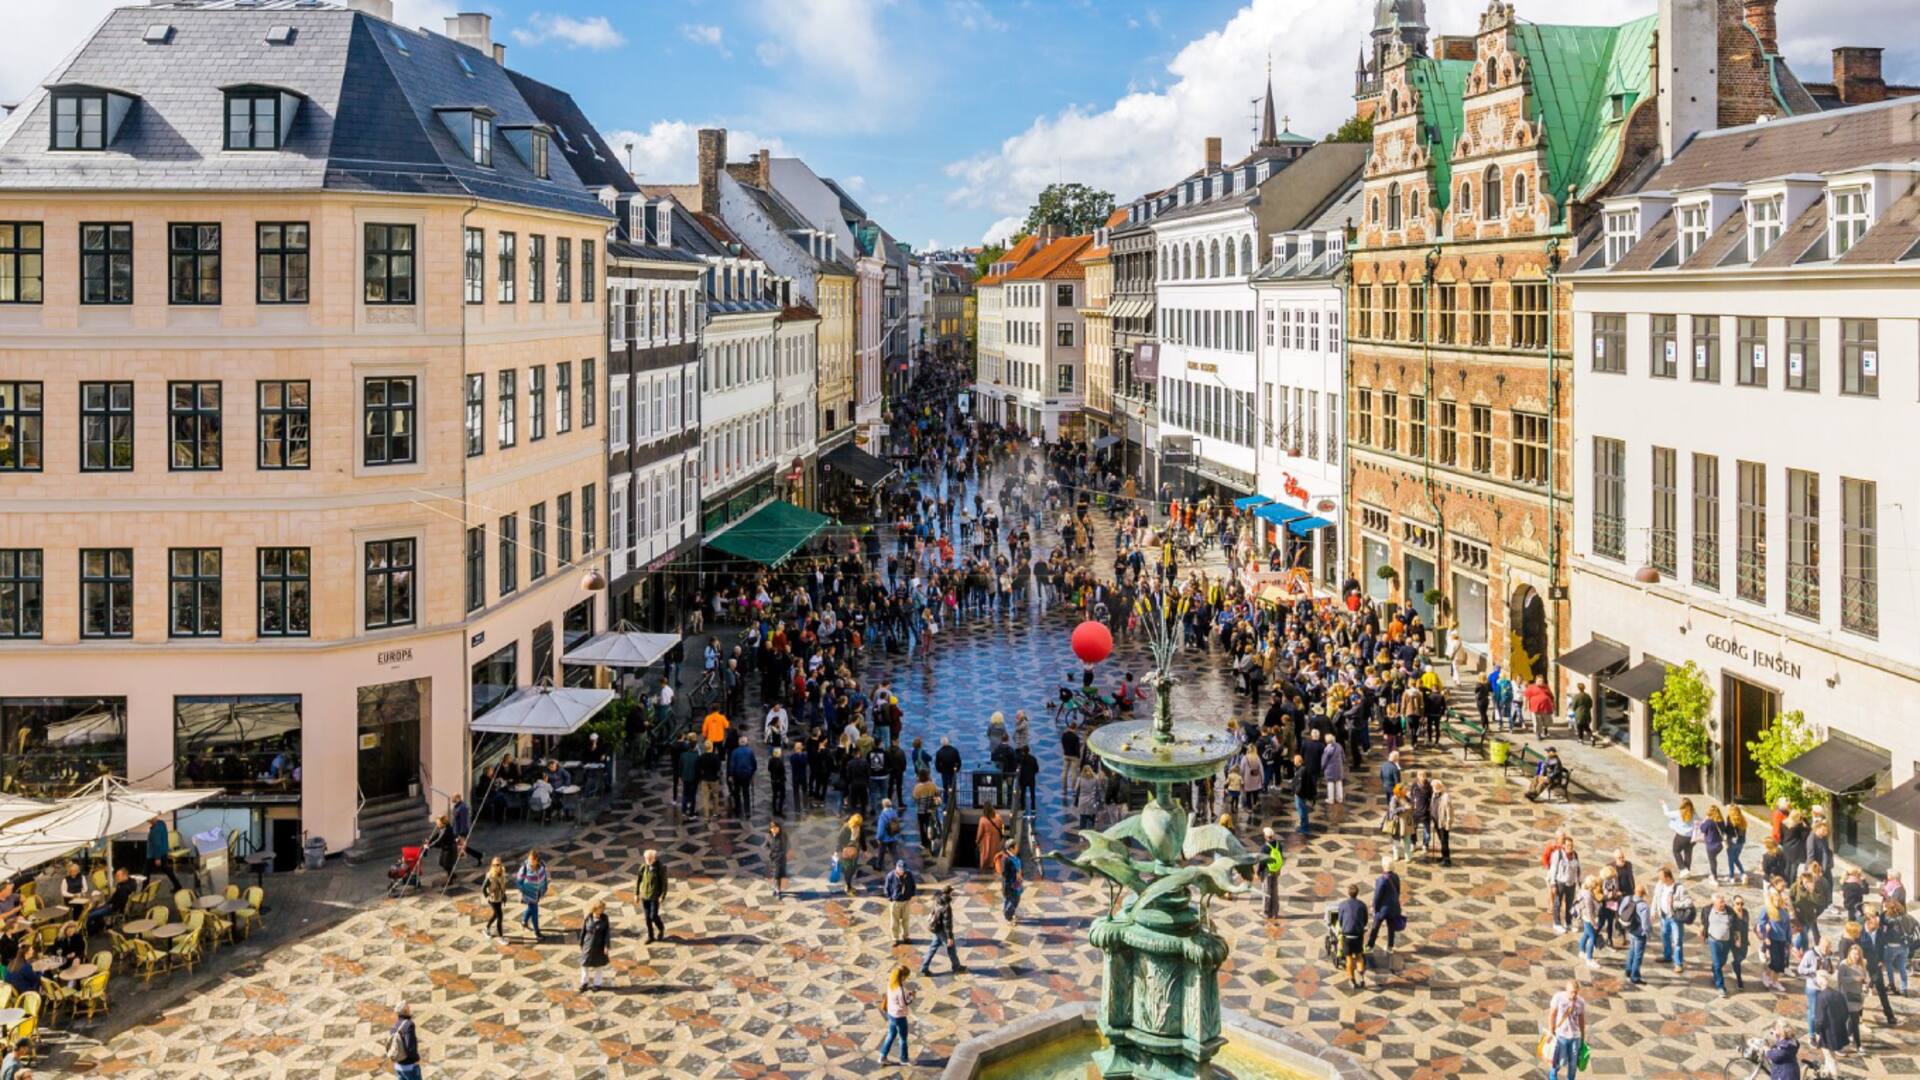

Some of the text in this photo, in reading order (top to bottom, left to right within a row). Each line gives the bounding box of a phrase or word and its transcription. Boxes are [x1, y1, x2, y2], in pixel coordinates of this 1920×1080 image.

[377, 648, 413, 665] EUROPA
[1706, 633, 1800, 680] GEORG JENSEN
